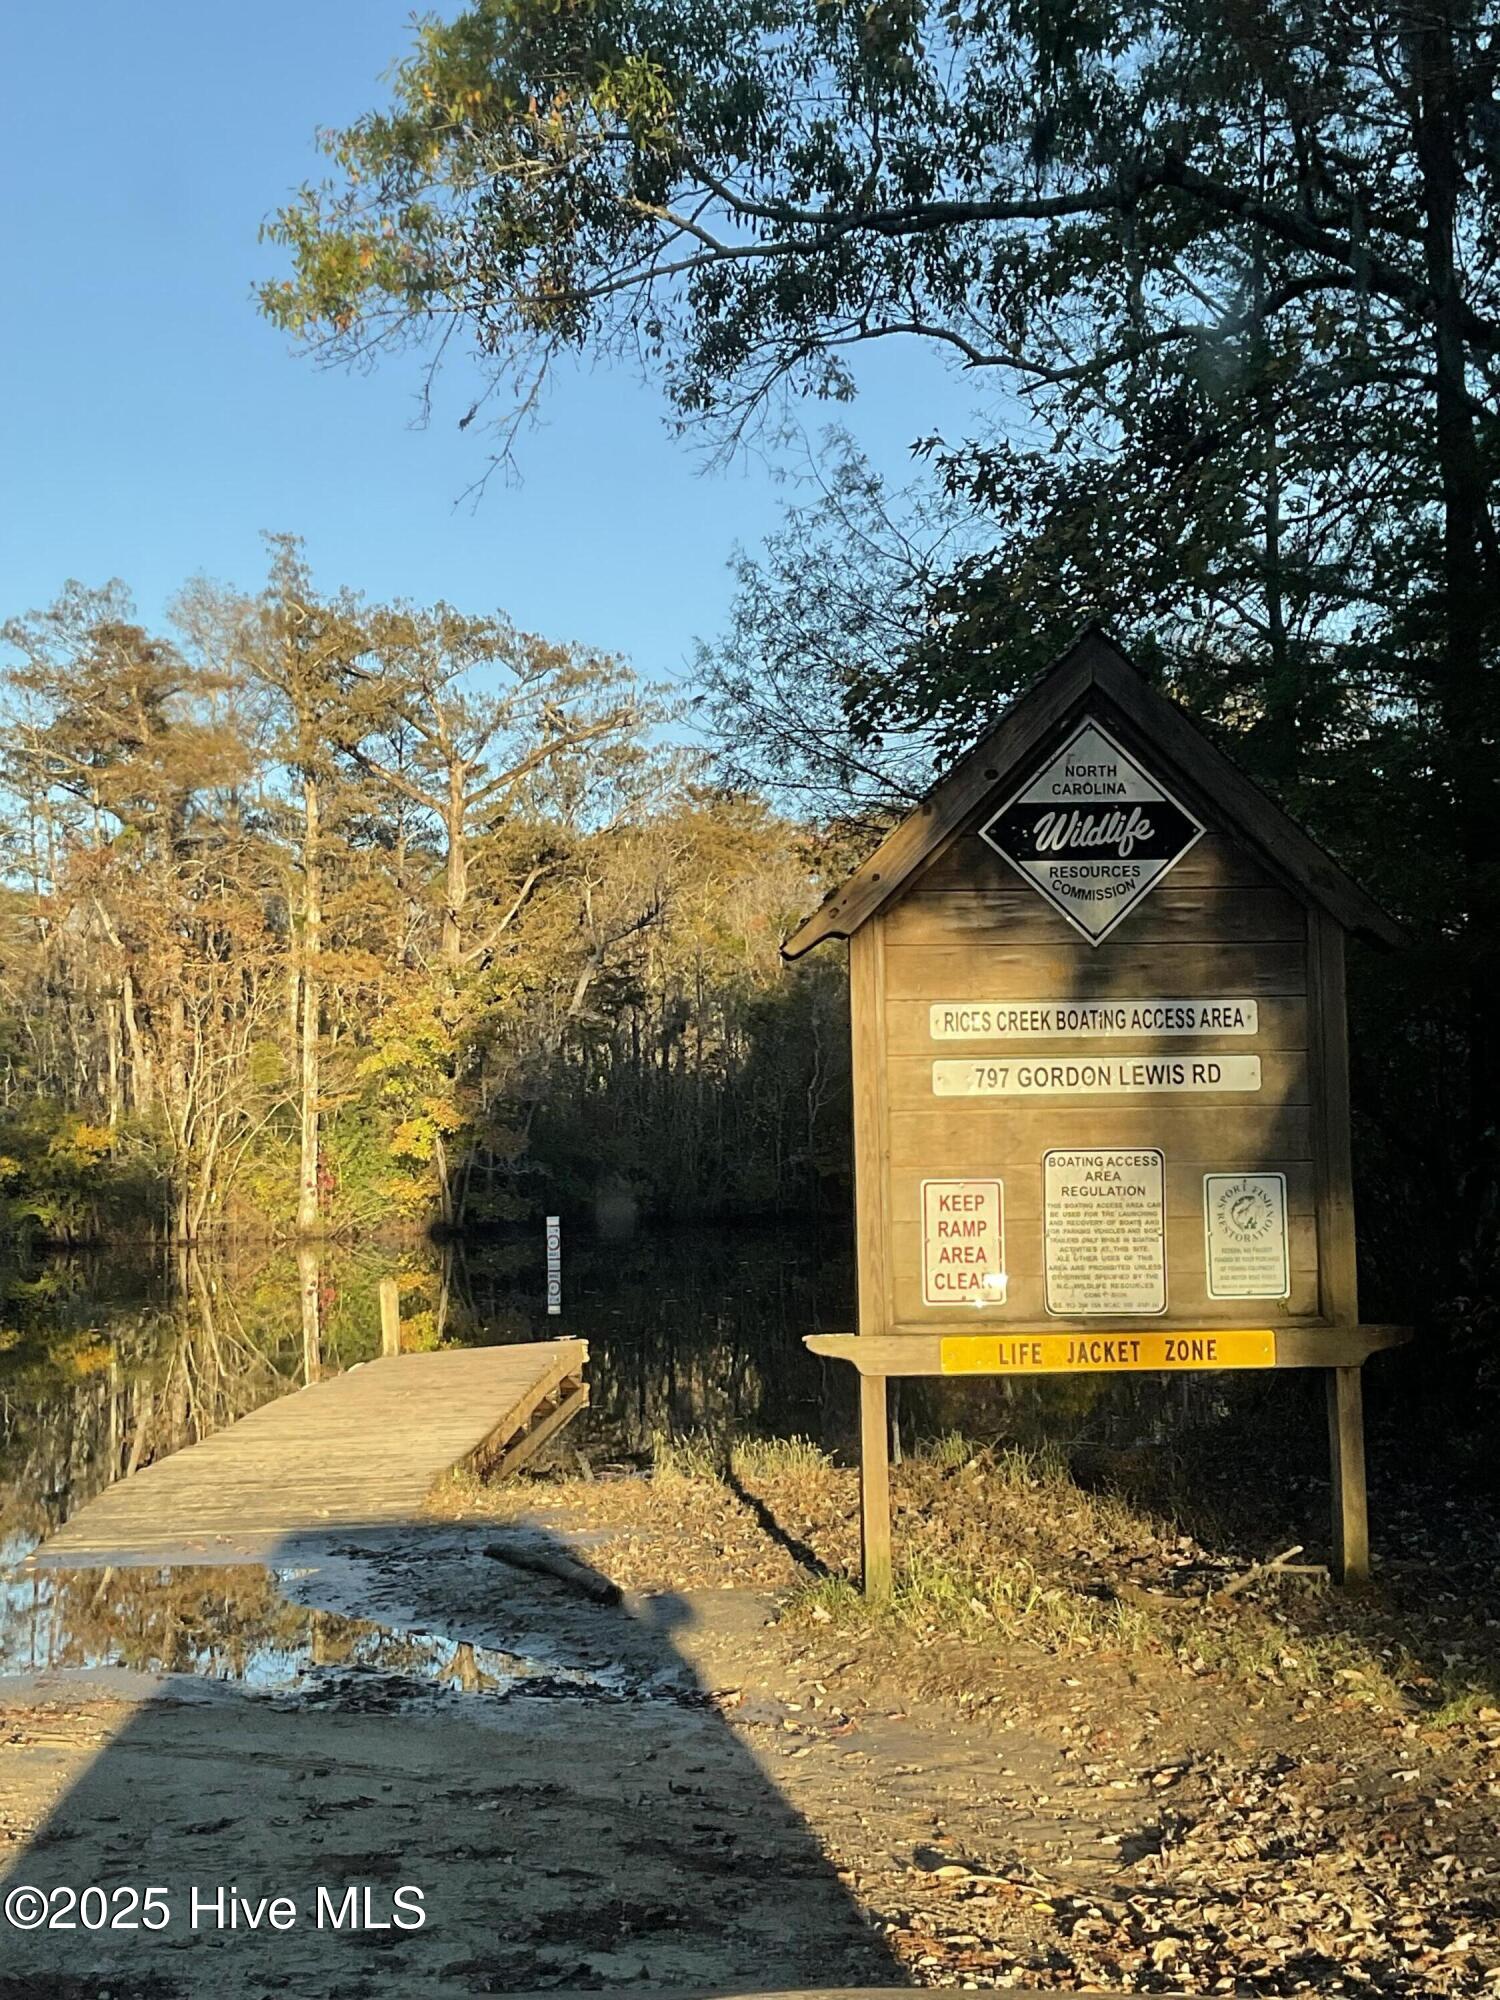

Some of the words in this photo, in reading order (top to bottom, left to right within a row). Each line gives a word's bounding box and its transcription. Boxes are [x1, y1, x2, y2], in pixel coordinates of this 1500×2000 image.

[1065, 765, 1117, 778] NORTH
[1052, 782, 1127, 795] CAROLINA
[1033, 807, 1155, 857] Wildlife
[1050, 866, 1140, 878] RESOURCES
[1052, 878, 1136, 901] COMMISSION
[944, 1011, 991, 1032] RICES
[997, 1010, 1051, 1032] CREEK
[1056, 1009, 1126, 1030] BOATING
[1131, 1008, 1195, 1029] ACCESS
[1200, 1008, 1245, 1028] AREA
[975, 1068, 1010, 1088] 797
[1017, 1066, 1111, 1087] GORDON
[1120, 1065, 1184, 1085] LEWIS
[1193, 1064, 1221, 1084] RD
[1048, 1156, 1103, 1167] BOATING
[1106, 1156, 1158, 1166] ACCESS
[1085, 1171, 1121, 1182] AREA
[1061, 1186, 1146, 1197] REGULATION
[939, 1195, 985, 1212] KEEP
[938, 1220, 987, 1238] RAMP
[939, 1247, 987, 1264] AREA
[999, 1342, 1042, 1365] LIFE
[1068, 1341, 1141, 1364] JACKET
[1165, 1339, 1217, 1361] ZONE
